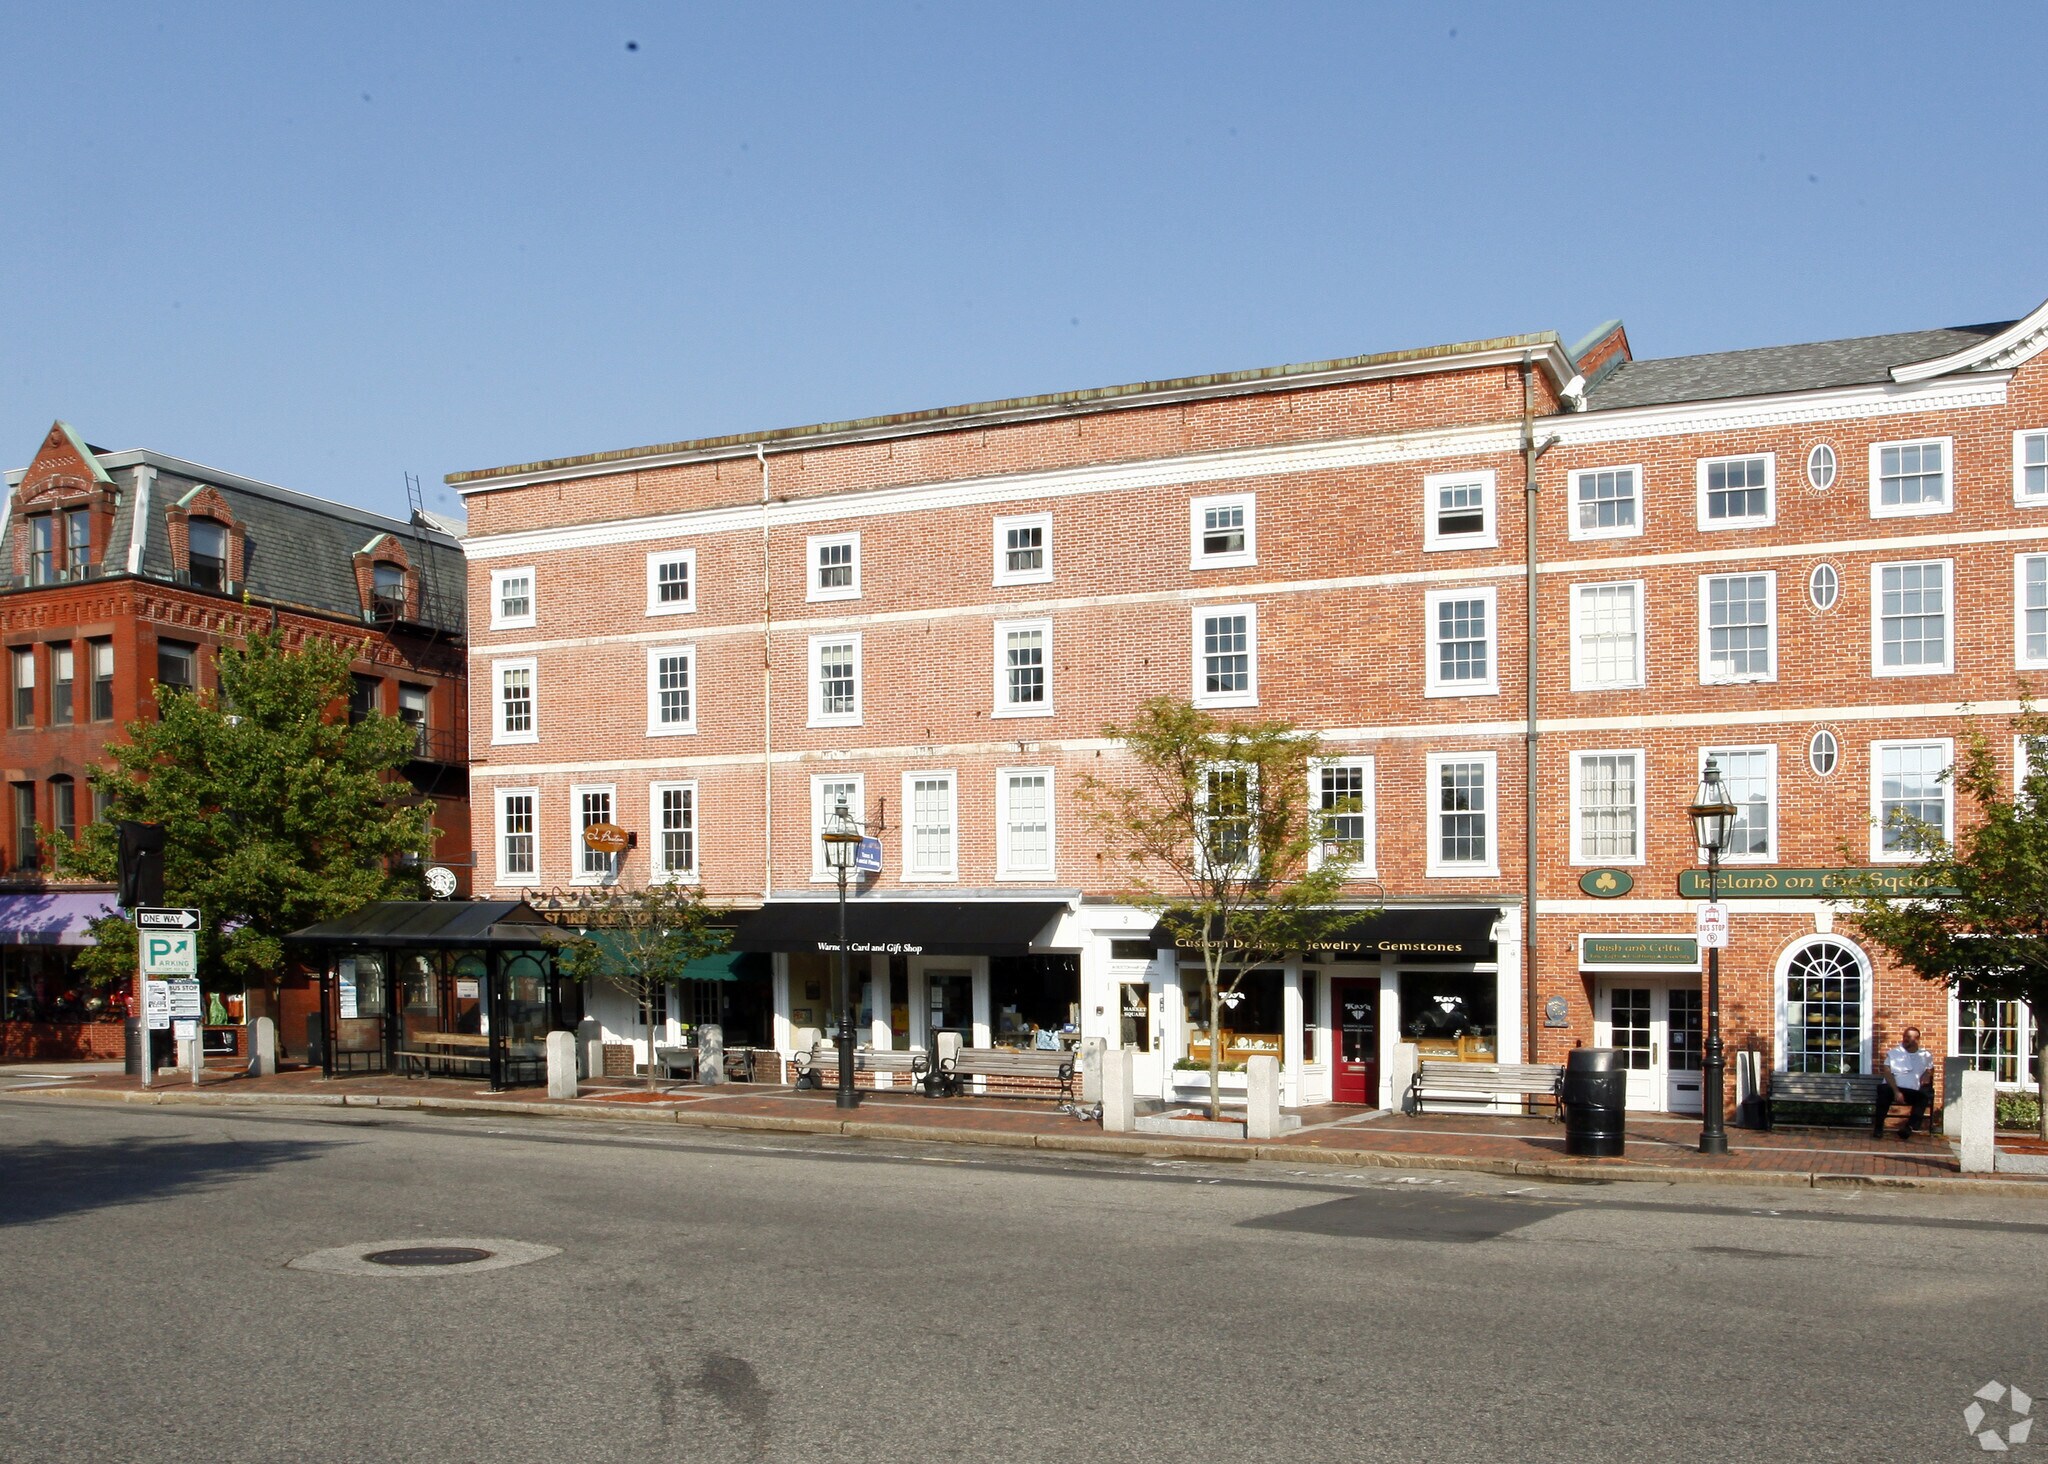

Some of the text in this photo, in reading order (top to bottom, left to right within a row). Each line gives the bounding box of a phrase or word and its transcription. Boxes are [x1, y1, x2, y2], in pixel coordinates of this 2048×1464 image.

[1784, 876, 1814, 888] on
[1869, 872, 1957, 893] Squa
[143, 914, 181, 923] ONE WAY
[1123, 915, 1129, 924] 3
[851, 942, 870, 951] Card
[871, 943, 886, 951] and
[886, 943, 902, 955] Gift
[903, 943, 923, 955] Shop
[1175, 938, 1229, 948] Cusom
[1378, 941, 1462, 952] Gemstones
[1595, 943, 1622, 952] Irish
[1625, 943, 1647, 952] and
